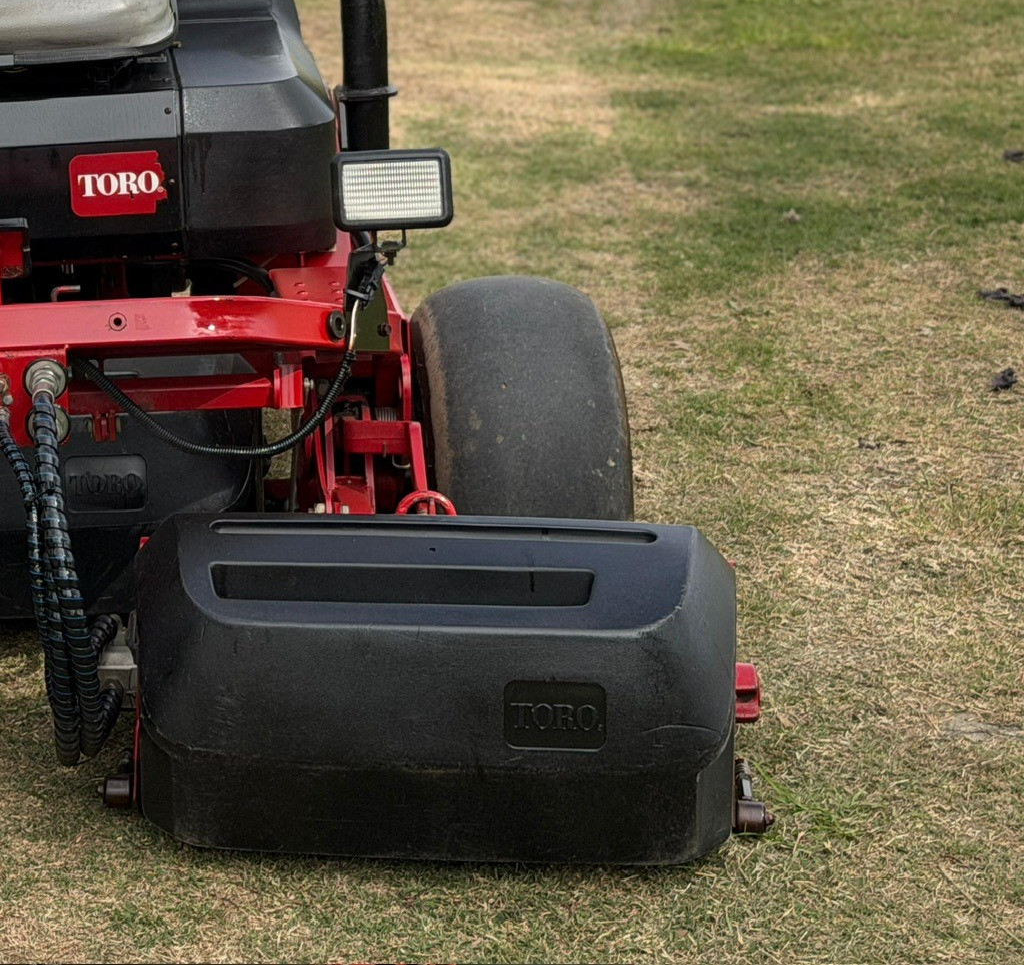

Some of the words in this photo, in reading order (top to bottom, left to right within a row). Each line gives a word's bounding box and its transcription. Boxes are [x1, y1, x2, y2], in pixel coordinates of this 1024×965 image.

[77, 170, 160, 198] TORO
[69, 473, 143, 496] TORO
[510, 703, 597, 731] TORO
